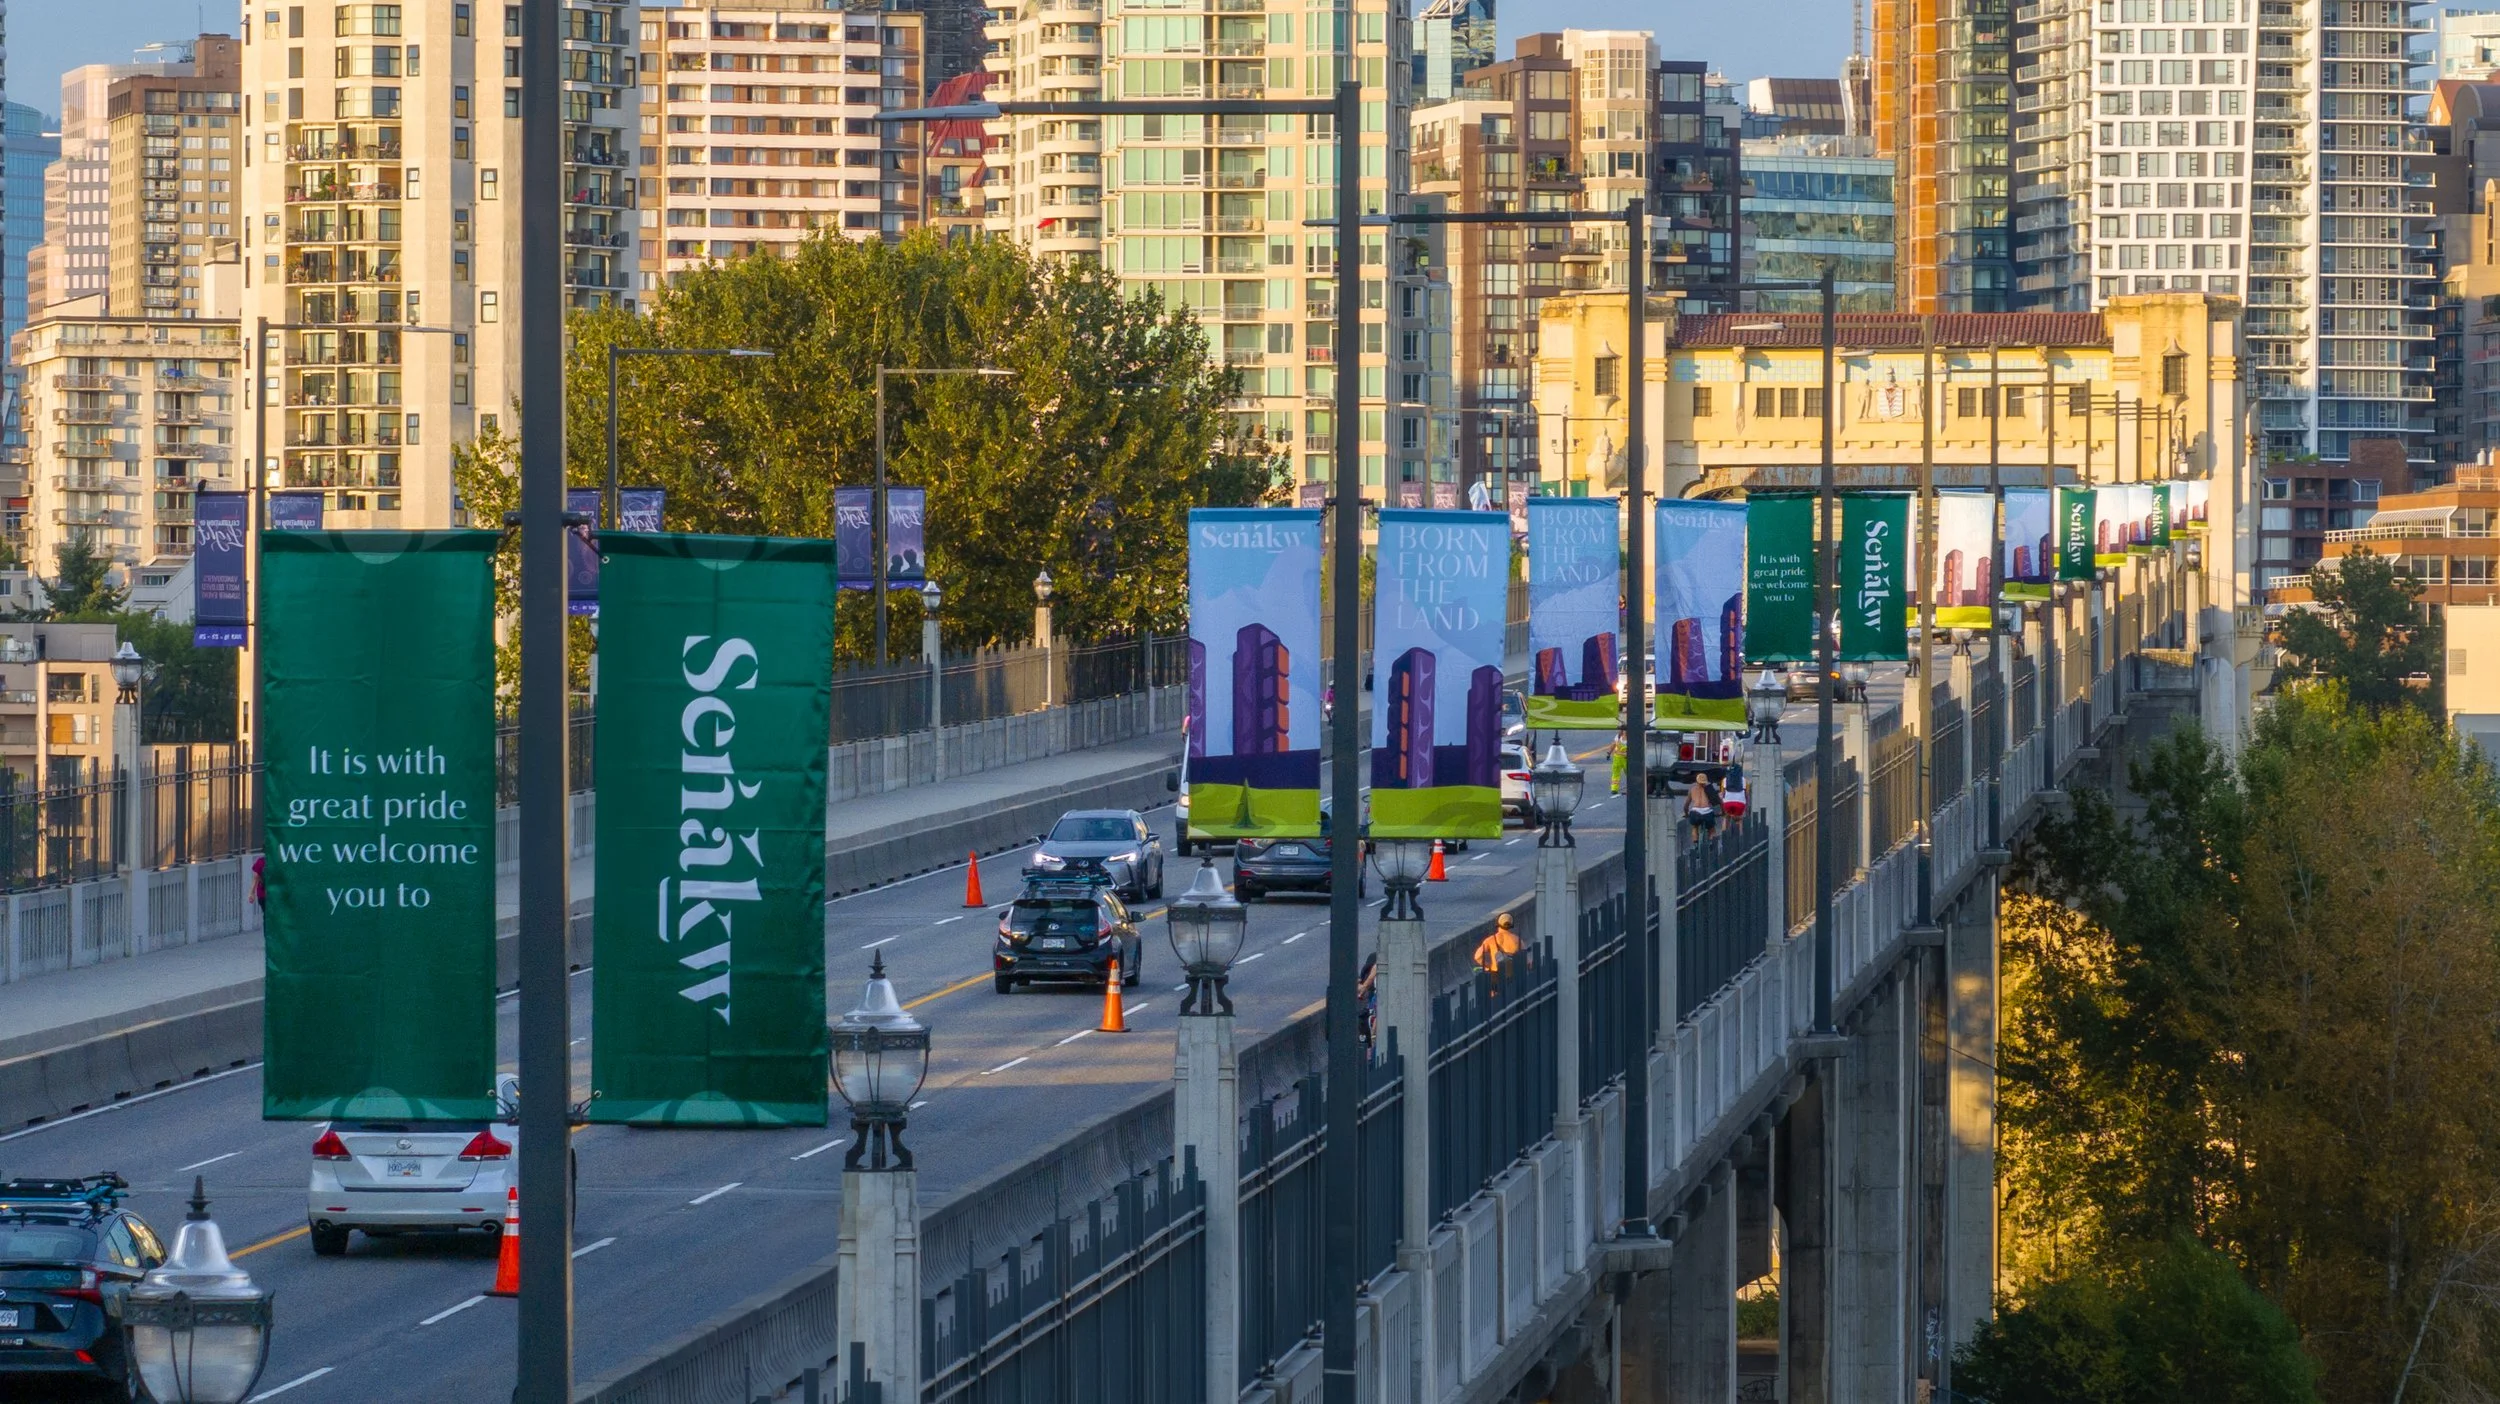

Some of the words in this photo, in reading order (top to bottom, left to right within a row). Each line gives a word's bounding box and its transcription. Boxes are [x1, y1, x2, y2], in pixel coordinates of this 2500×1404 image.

[1542, 507, 1606, 525] BORN
[1400, 525, 1490, 552] BORN
[1542, 527, 1606, 544] FROM
[1399, 551, 1488, 578] FROM
[1539, 545, 1581, 564] THE
[1760, 554, 1767, 563] It
[1769, 555, 1777, 563] is
[1779, 554, 1800, 563] with
[1542, 564, 1601, 582] LAND
[1753, 568, 1778, 579] great
[1780, 567, 1806, 579] pride
[1766, 579, 1809, 589] welcome
[1391, 578, 1456, 604] THE
[1764, 594, 1782, 603] you
[1784, 594, 1795, 602] to
[1397, 604, 1480, 631] LAND
[310, 745, 332, 775] It
[344, 747, 367, 775] is
[377, 745, 446, 775] with
[288, 794, 374, 827] great
[384, 790, 467, 827] pride
[279, 842, 322, 863] we
[332, 833, 478, 865] welcome
[326, 887, 385, 916] you
[397, 882, 430, 908] to
